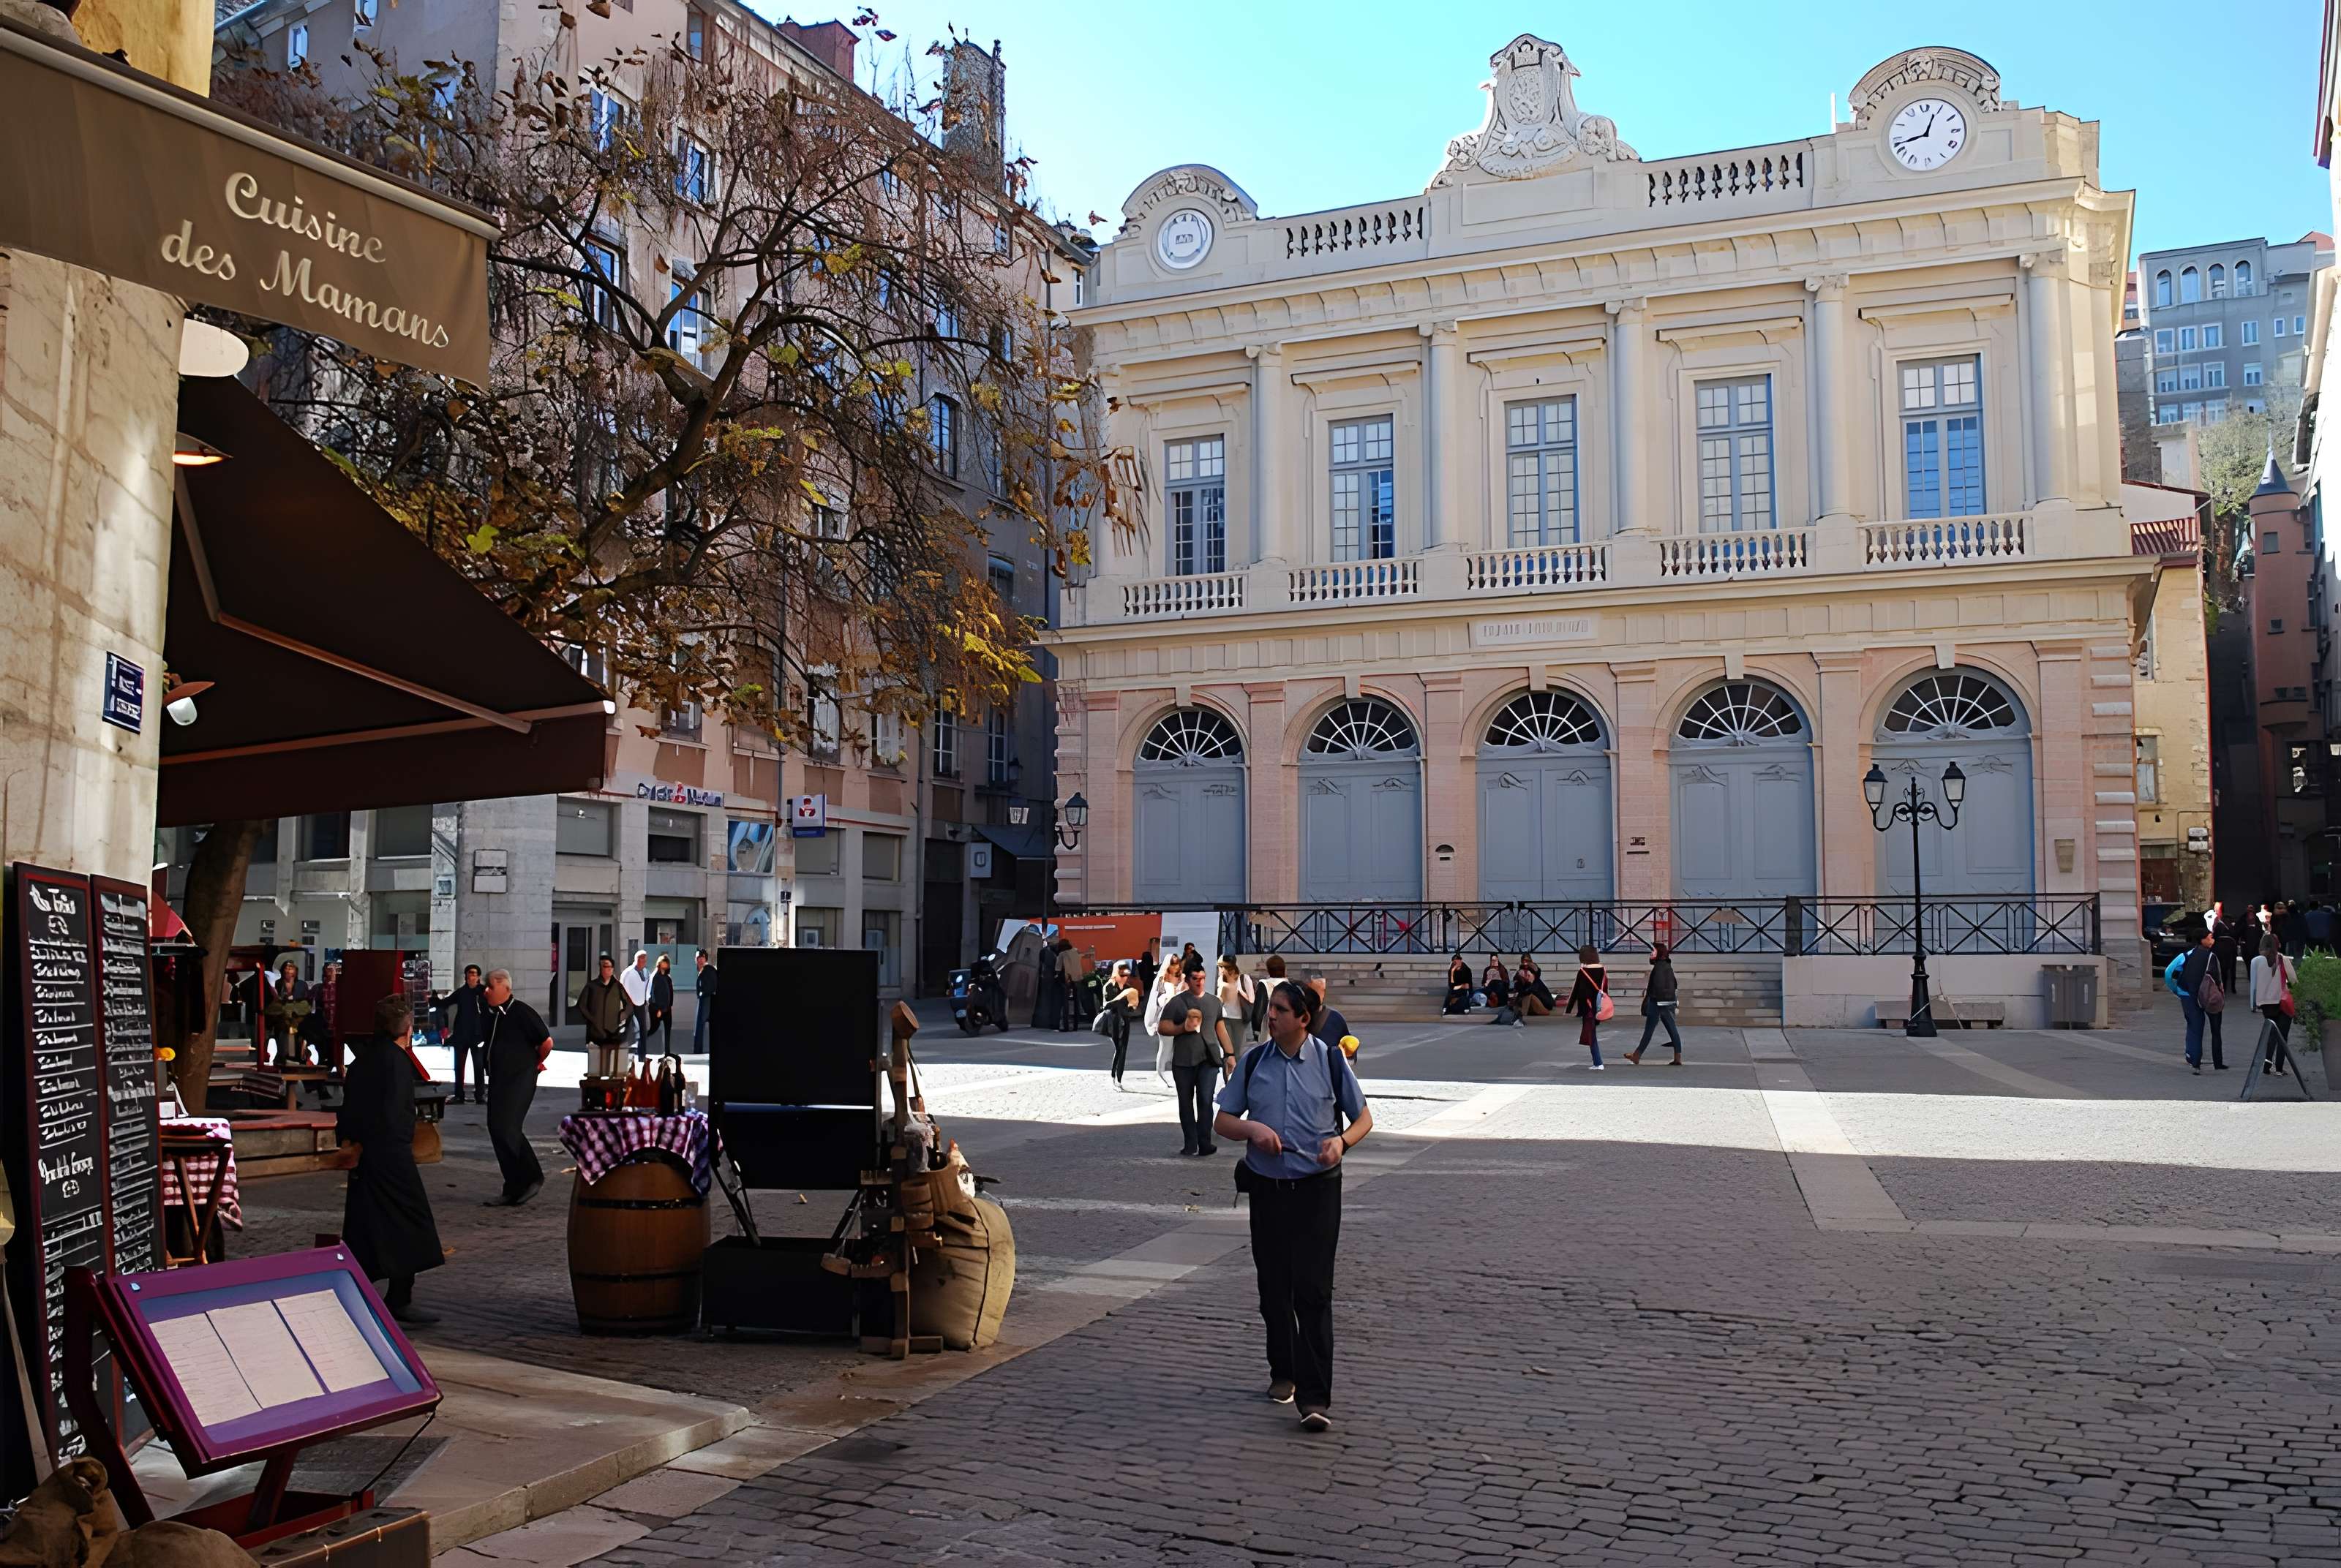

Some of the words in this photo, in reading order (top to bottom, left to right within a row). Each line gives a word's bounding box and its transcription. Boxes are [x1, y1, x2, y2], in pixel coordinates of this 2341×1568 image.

[225, 172, 386, 263] Cuisine
[161, 219, 236, 281] des
[260, 250, 449, 348] Mamans
